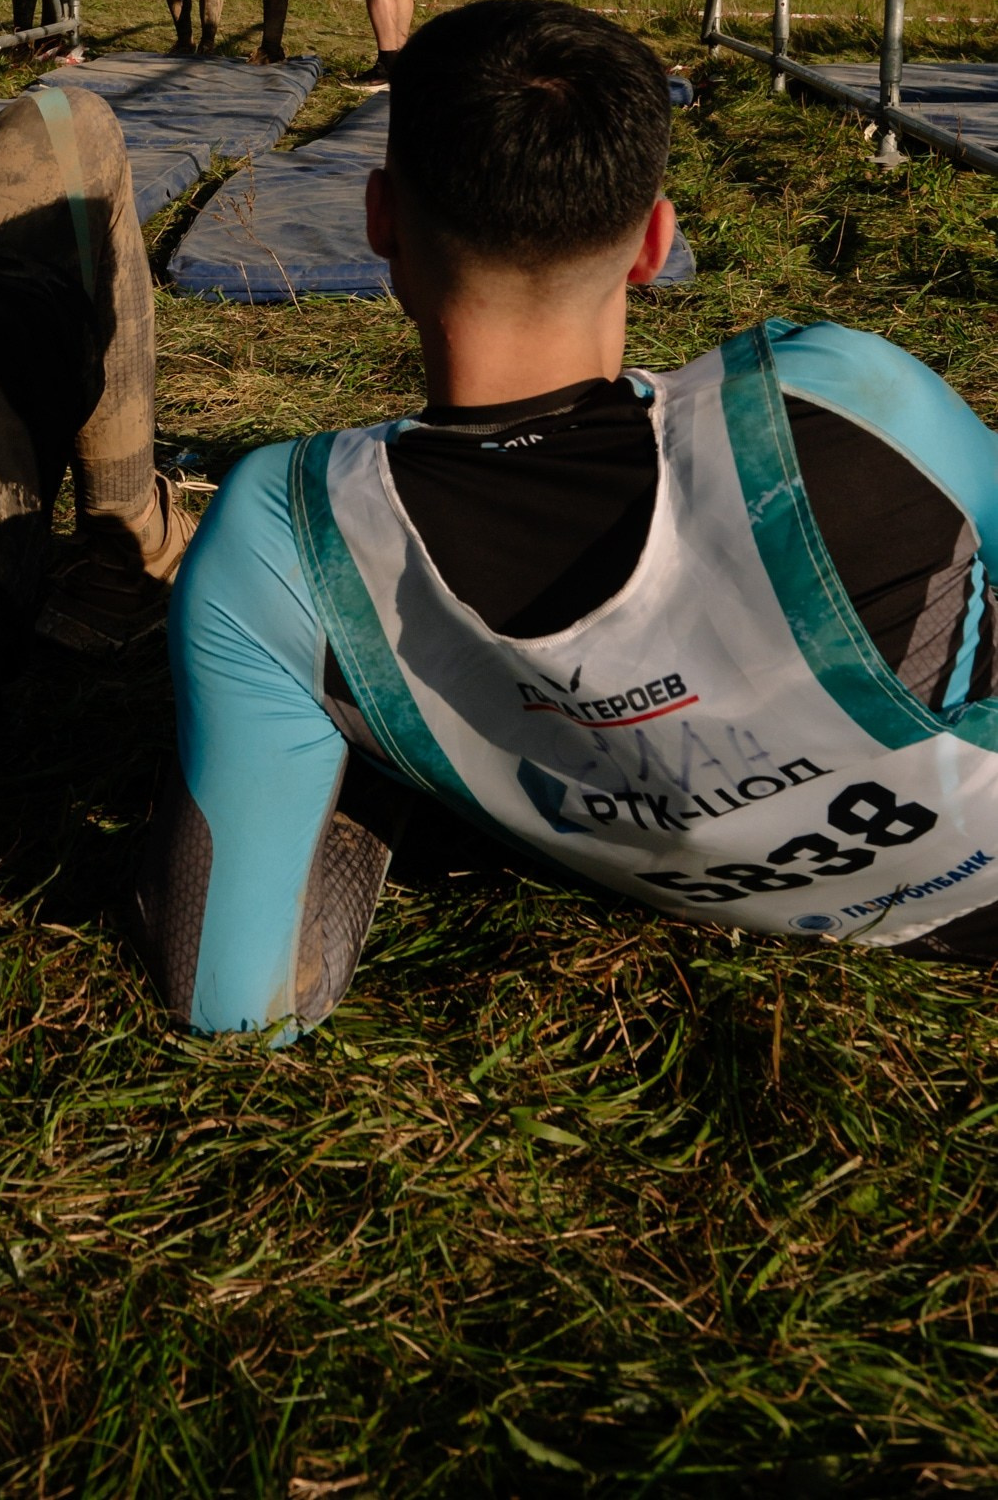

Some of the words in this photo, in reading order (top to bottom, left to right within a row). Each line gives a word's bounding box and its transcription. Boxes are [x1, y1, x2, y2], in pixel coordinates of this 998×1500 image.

[578, 673, 687, 721] ГЕРОЕВ
[582, 757, 833, 832] РТК-ЦОД
[635, 781, 938, 903] 5838
[840, 850, 994, 918] ГАЗПРОМБАНК
